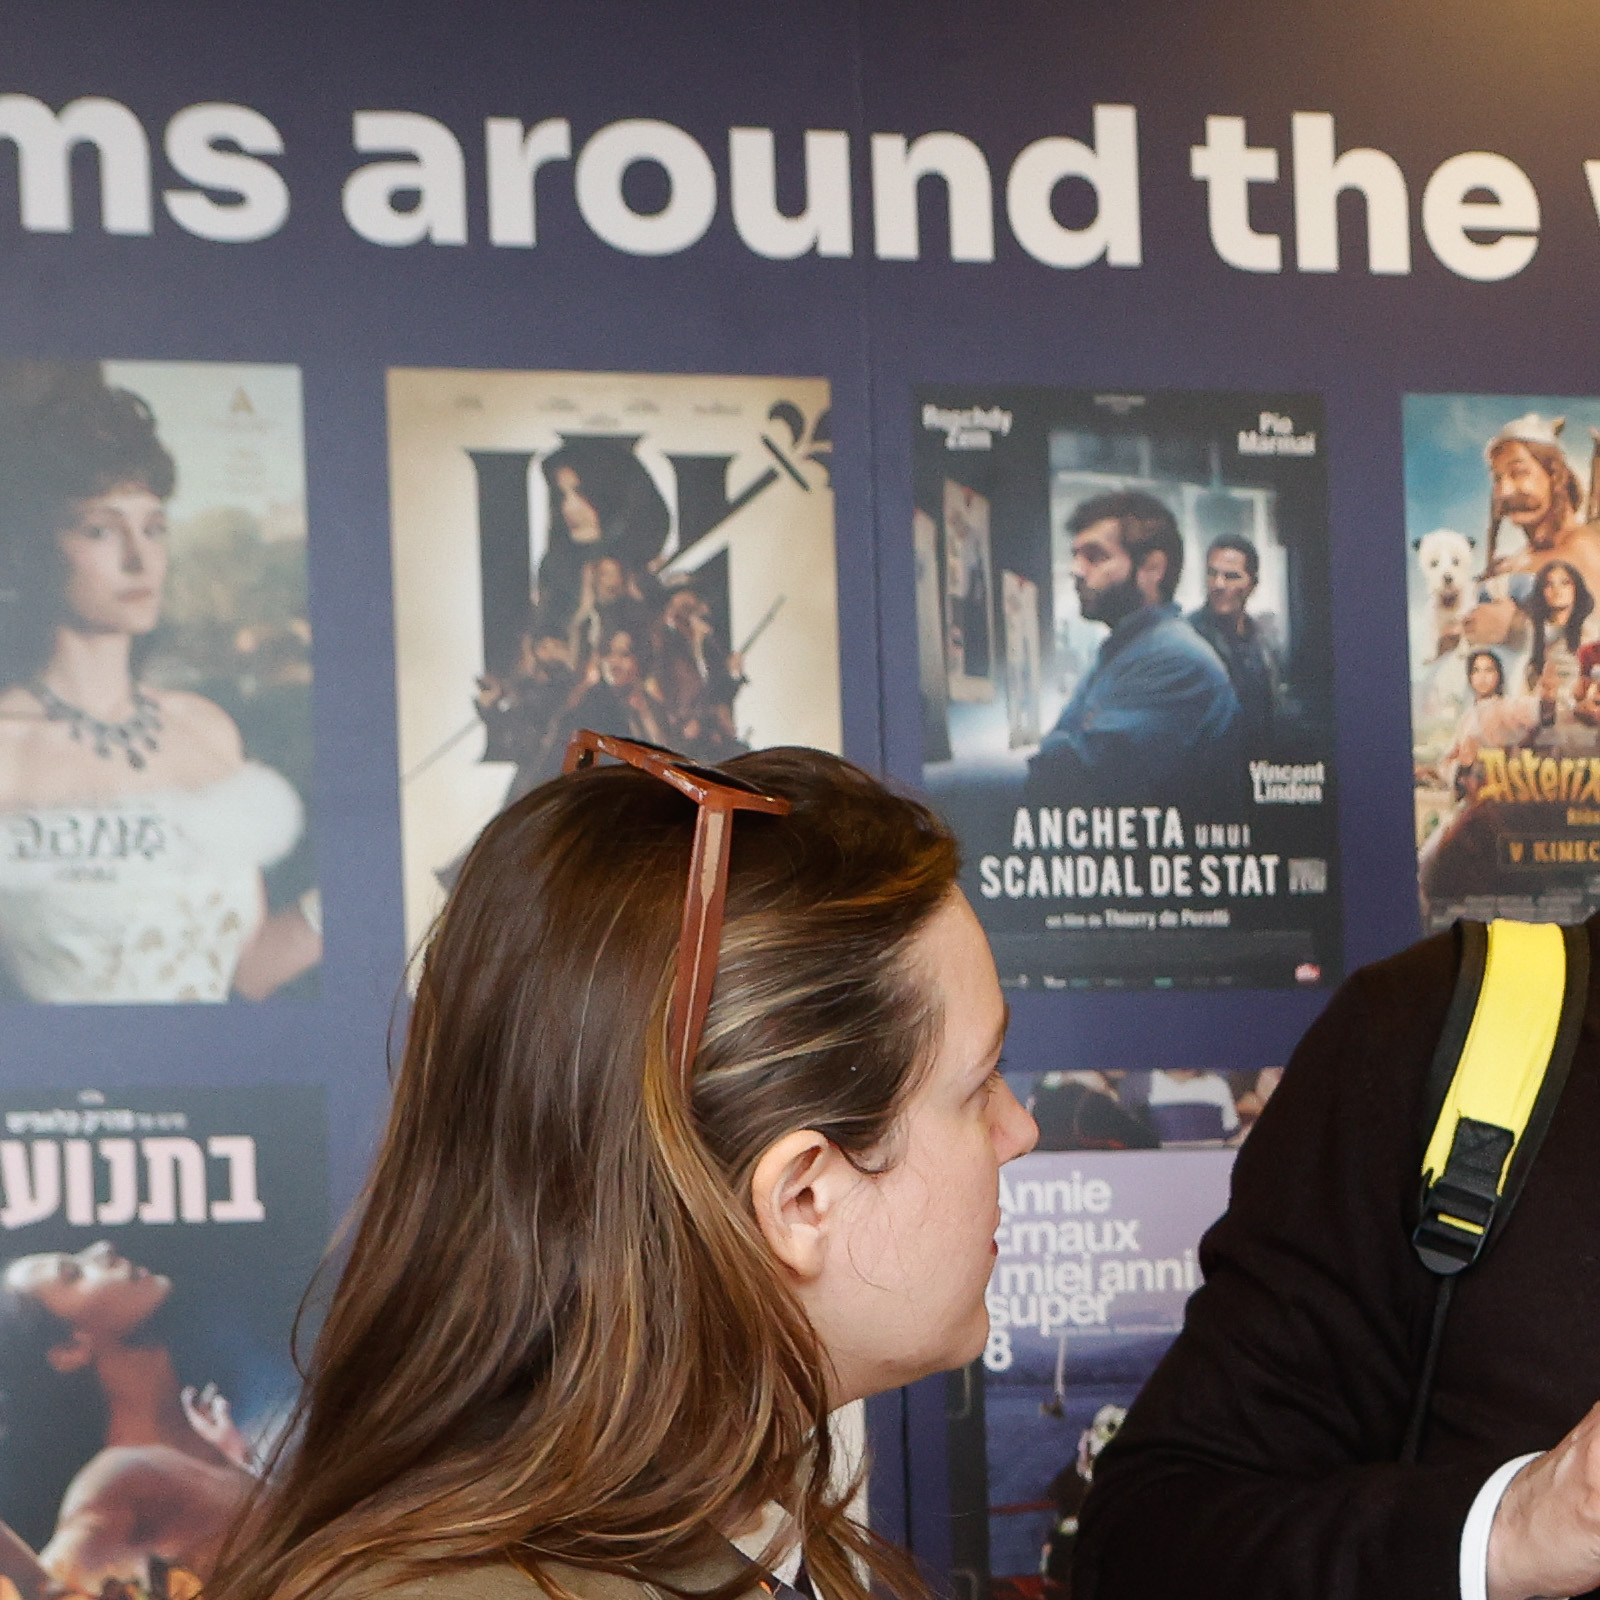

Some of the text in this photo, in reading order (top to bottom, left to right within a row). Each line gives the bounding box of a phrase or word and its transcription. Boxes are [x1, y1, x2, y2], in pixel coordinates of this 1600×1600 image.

[342, 103, 1142, 269] around
[1190, 111, 1542, 281] the
[1012, 806, 1251, 850] ANCHETA UNUI
[980, 854, 1144, 899] SCANDAL
[1150, 855, 1193, 897] DE
[1199, 854, 1280, 898] STAT
[989, 1292, 1114, 1338] super
[984, 1328, 1013, 1373] 8
